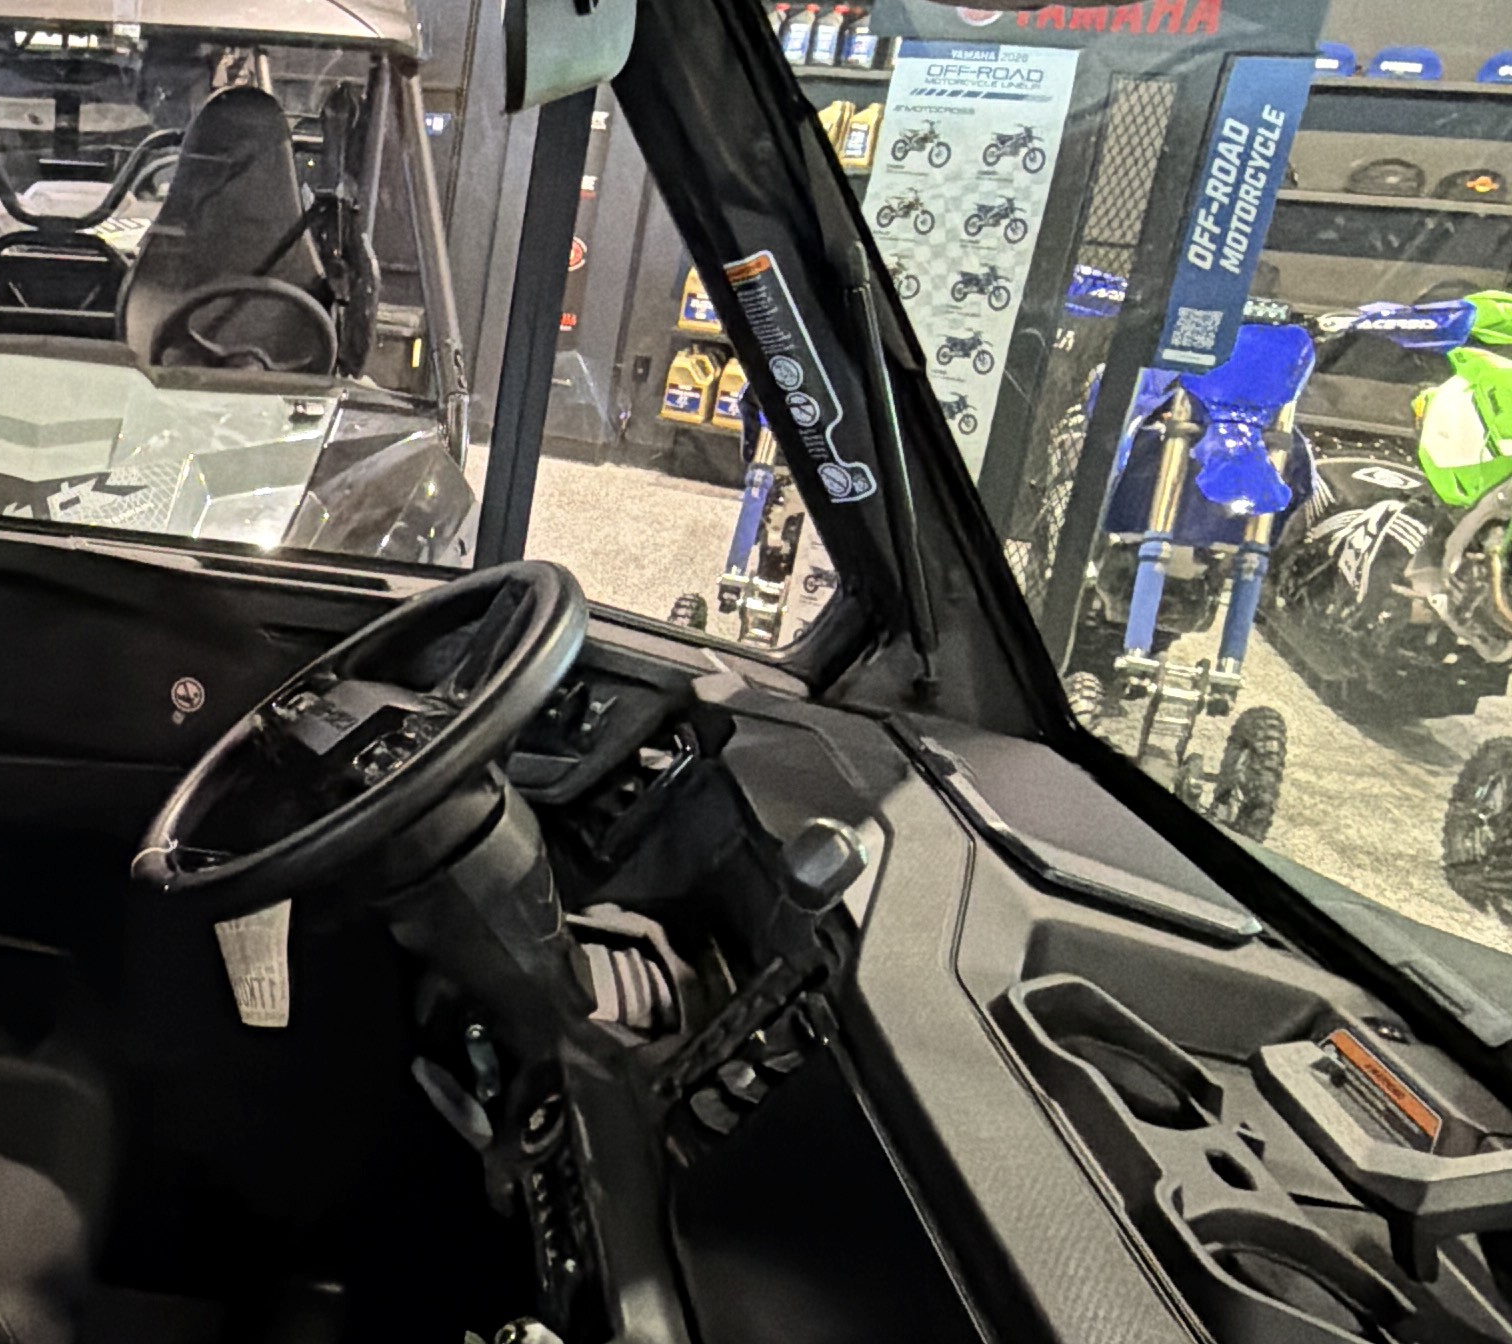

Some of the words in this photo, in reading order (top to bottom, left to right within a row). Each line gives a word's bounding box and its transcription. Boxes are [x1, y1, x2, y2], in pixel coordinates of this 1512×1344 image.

[951, 48, 996, 61] YAMAHA
[924, 77, 998, 89] MOTORCYCLE
[926, 63, 1044, 84] OFF-ROAD
[1187, 117, 1250, 272] OFF-ROAD
[1219, 104, 1286, 274] MOTORCYCLE
